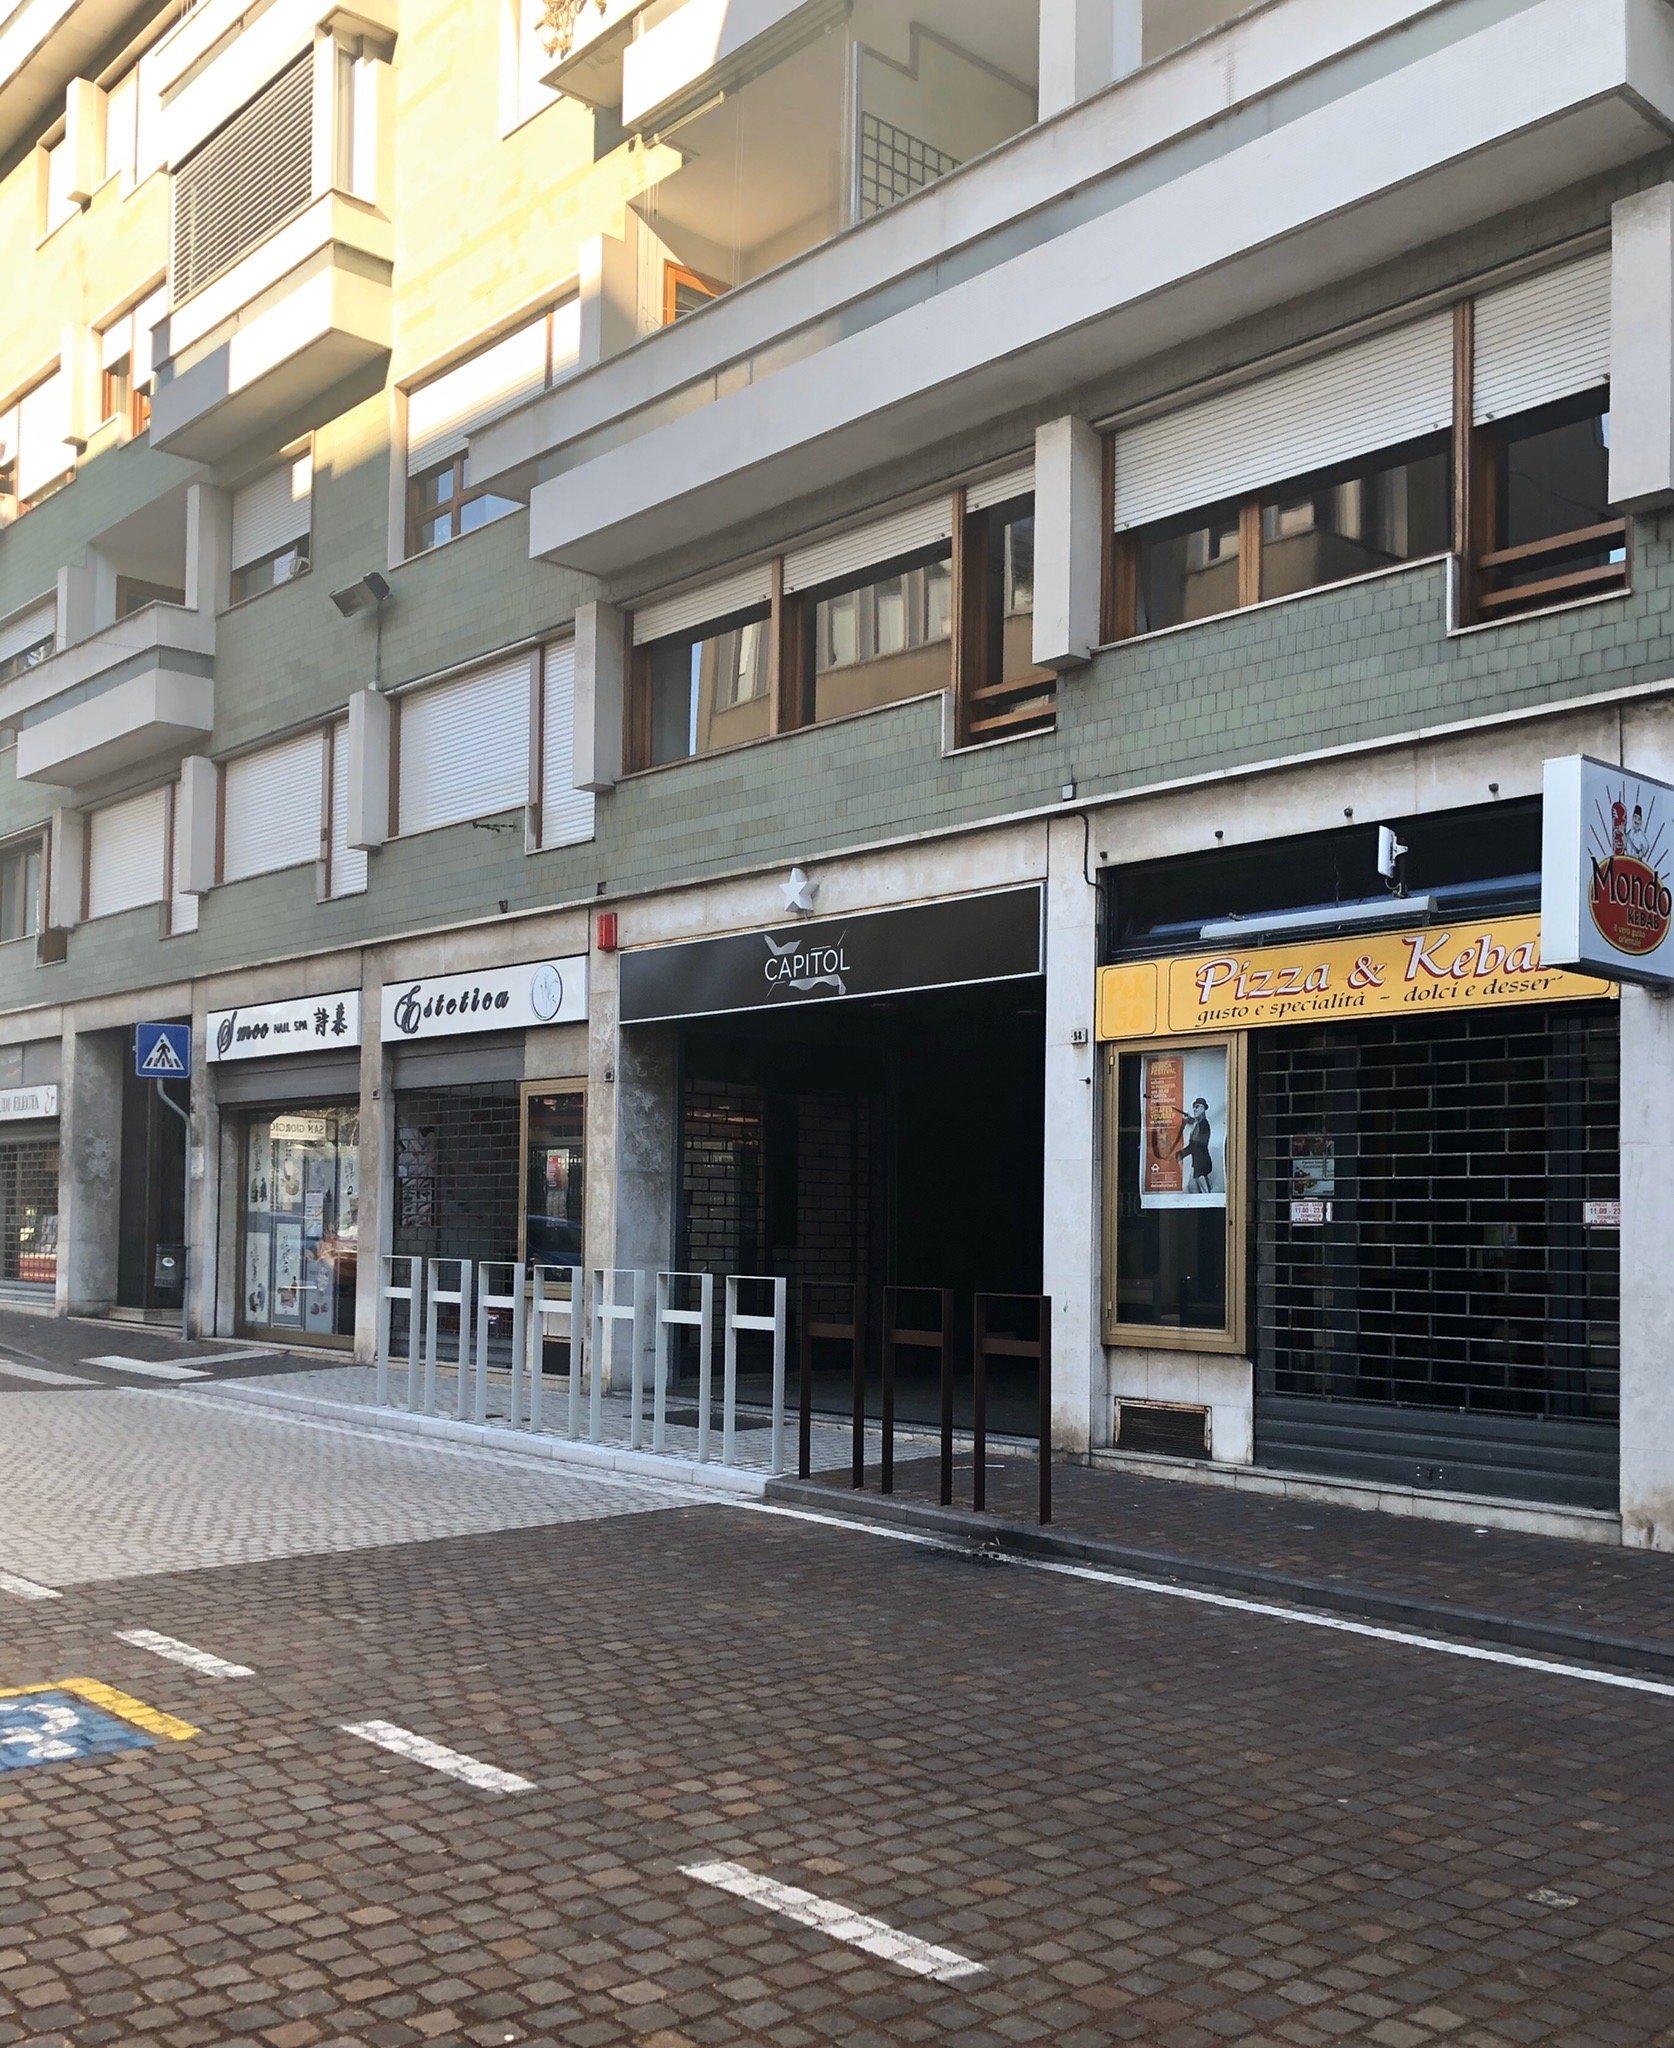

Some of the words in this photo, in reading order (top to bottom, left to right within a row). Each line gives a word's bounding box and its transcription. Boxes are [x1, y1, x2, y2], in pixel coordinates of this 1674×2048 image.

[1591, 856, 1672, 919] Mondo
[1627, 908, 1659, 931] KEBAB
[764, 948, 850, 981] CAPITOL
[1195, 957, 1331, 1005] Pizza
[1347, 955, 1387, 990] &
[1402, 932, 1552, 981] Keba
[273, 1022, 291, 1034] NAIL
[294, 1020, 308, 1031] SPA
[394, 985, 509, 1034] Estetica
[1194, 1003, 1249, 1027] gusto
[1255, 1004, 1265, 1016] e
[1270, 991, 1366, 1018] specialità
[1404, 981, 1457, 1002] dolci
[1465, 984, 1476, 997] e
